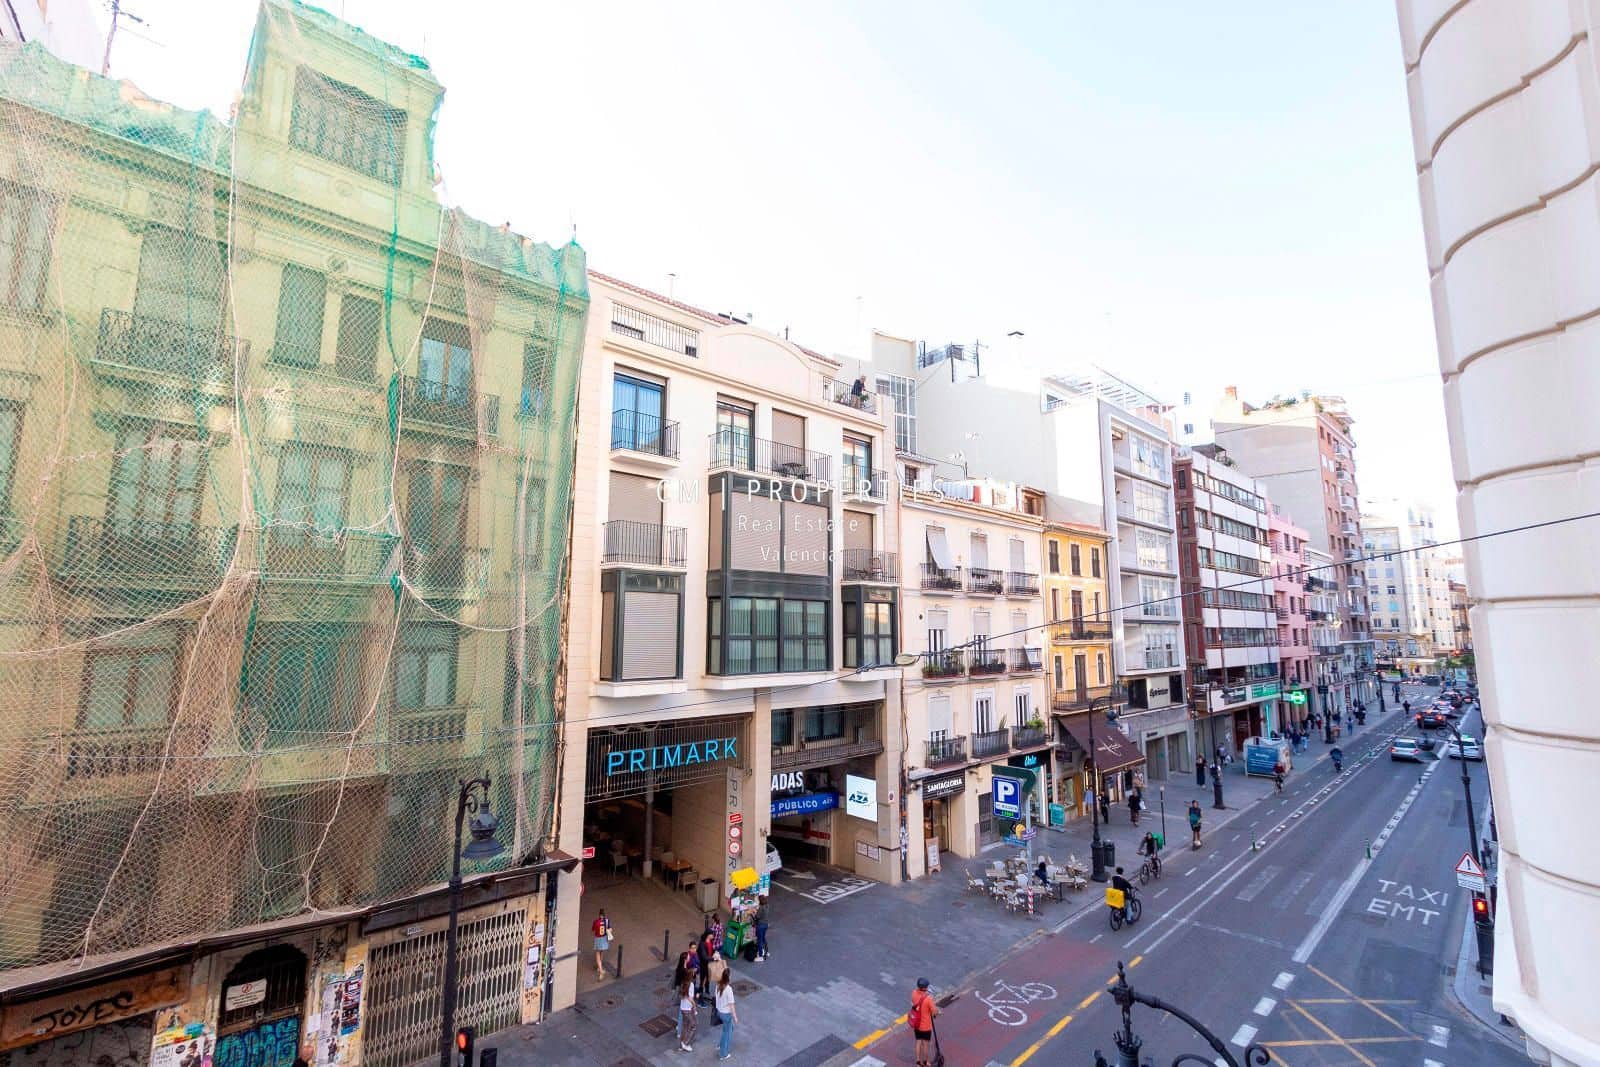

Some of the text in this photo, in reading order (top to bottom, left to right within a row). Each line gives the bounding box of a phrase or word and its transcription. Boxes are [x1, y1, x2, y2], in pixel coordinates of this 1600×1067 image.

[608, 737, 737, 777] PRIMARK
[997, 780, 1015, 802] P
[1378, 879, 1449, 906] TAXI
[1366, 897, 1441, 925] EMT
